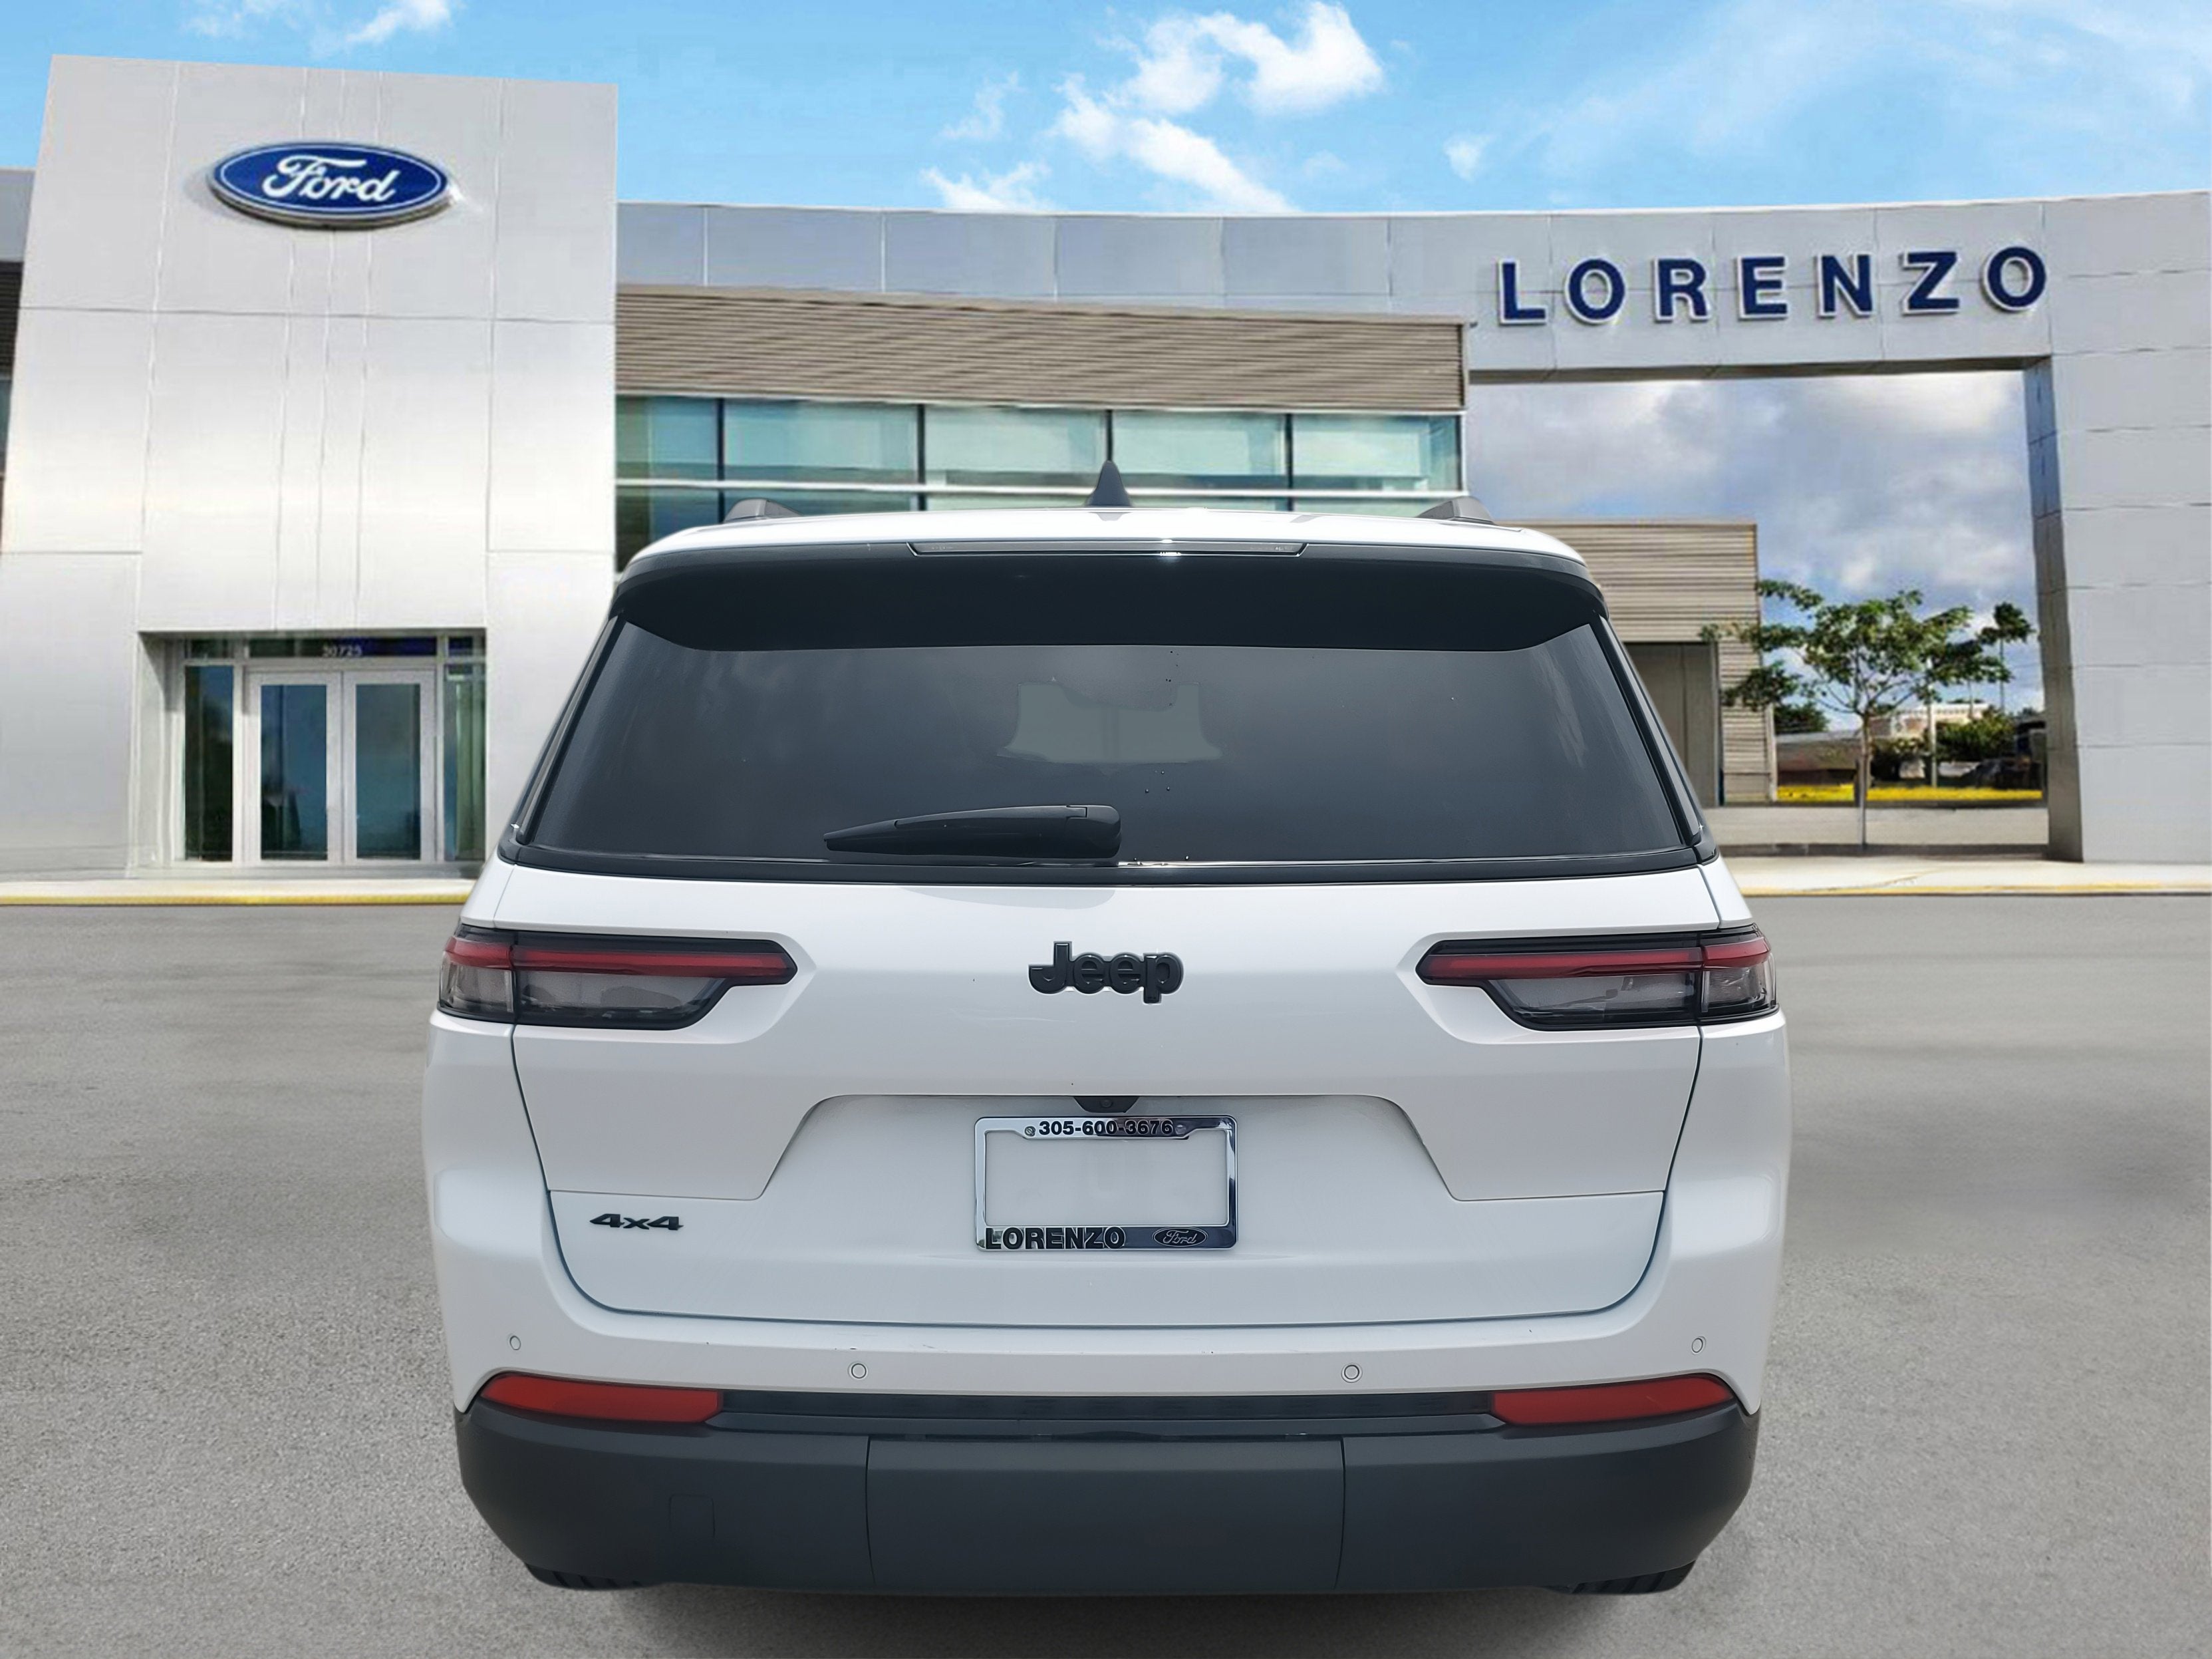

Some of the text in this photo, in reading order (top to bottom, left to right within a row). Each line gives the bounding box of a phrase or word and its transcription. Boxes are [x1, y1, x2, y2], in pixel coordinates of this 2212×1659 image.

[261, 154, 401, 202] Ford
[1500, 246, 2047, 324] LORENZO
[1028, 941, 1183, 1004] Jeep
[1039, 1120, 1174, 1136] 305-600-3676
[589, 1213, 684, 1231] 4x4
[985, 1227, 1198, 1250] LORENZO Ford
